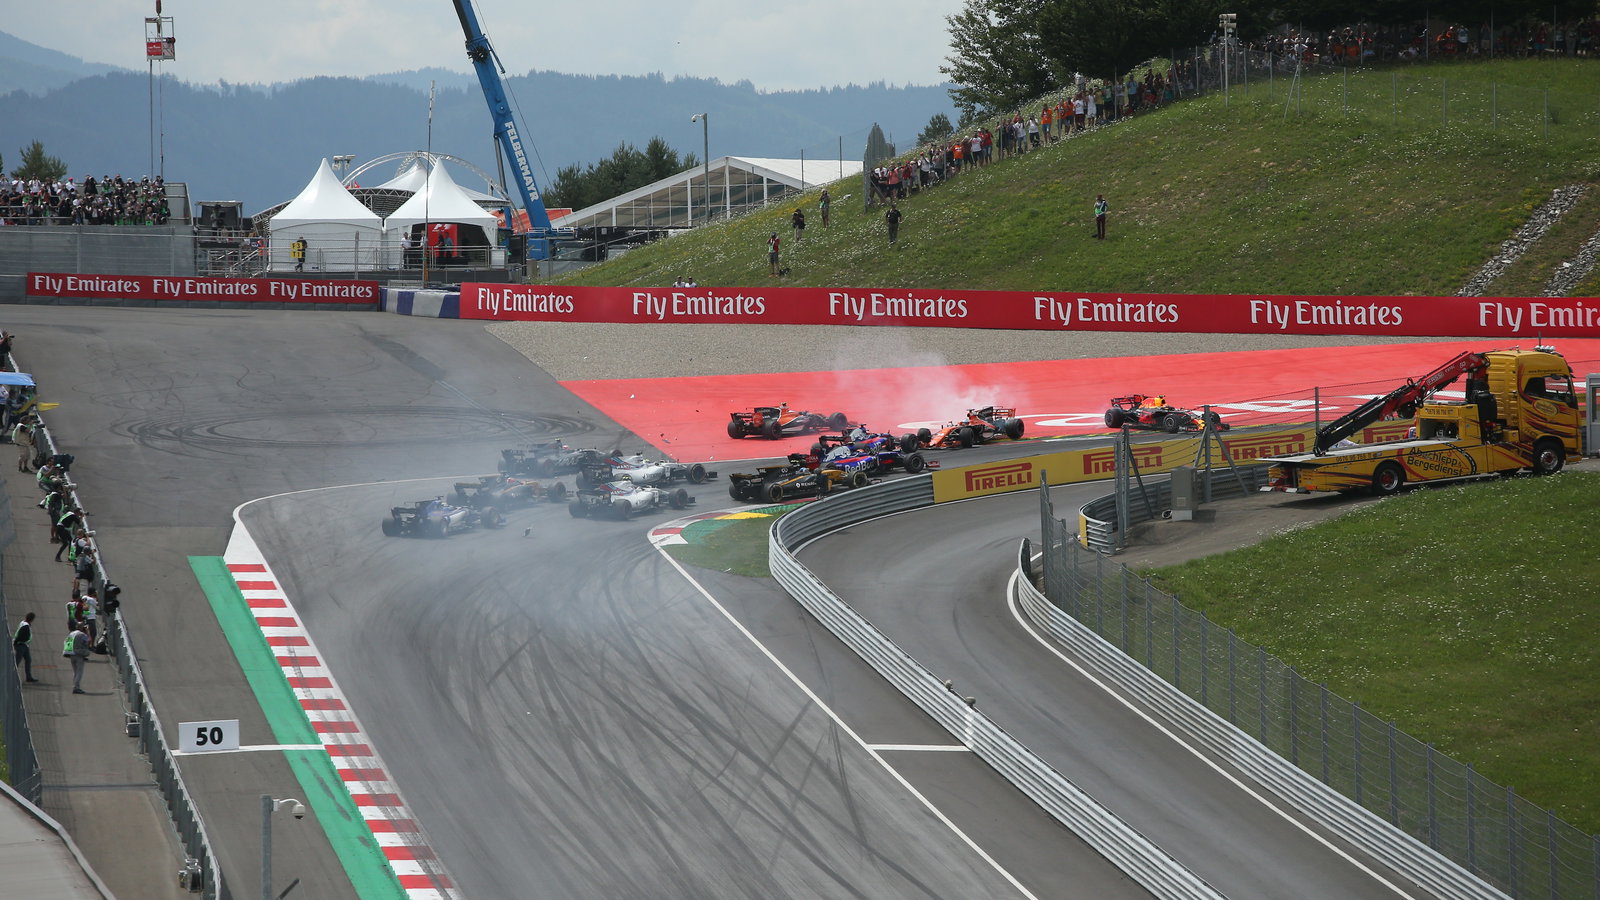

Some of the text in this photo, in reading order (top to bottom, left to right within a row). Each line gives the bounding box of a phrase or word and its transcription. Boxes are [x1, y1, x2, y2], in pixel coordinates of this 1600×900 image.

[505, 121, 539, 202] FELBERMAYR
[34, 275, 141, 294] Fly Emirates
[153, 279, 258, 297] Fly Emirates
[270, 281, 373, 300] Fly Emirates
[477, 287, 574, 316] Fly Emirates
[632, 292, 766, 321] Fly Emirates
[828, 292, 968, 321] Fly Emirates
[1033, 297, 1179, 326] Fly Emirates
[1249, 299, 1403, 330] Fly Emirates
[1478, 302, 1600, 332] Fly Emir
[1083, 446, 1163, 474] PIRLLI
[1221, 433, 1305, 461] PIRELLI
[965, 462, 1032, 492] PIRELLI
[1407, 456, 1464, 476] Bergedienst
[196, 726, 223, 746] 50
